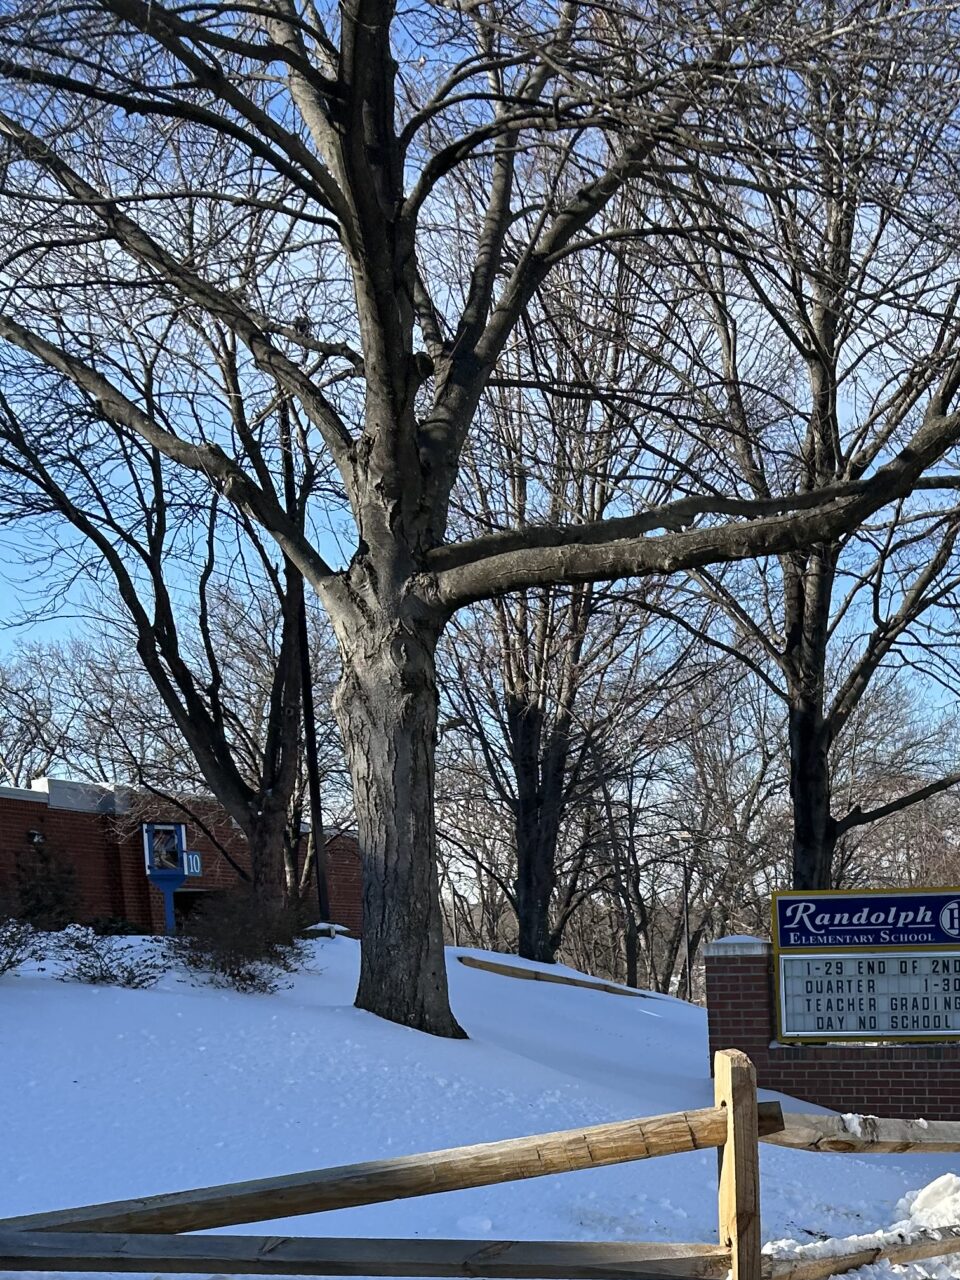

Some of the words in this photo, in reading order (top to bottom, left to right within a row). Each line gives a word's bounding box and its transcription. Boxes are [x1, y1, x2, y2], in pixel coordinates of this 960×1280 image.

[188, 854, 200, 873] 10
[783, 902, 935, 934] Randolph
[806, 961, 843, 976] 1-29
[857, 960, 886, 975] END
[900, 960, 918, 974] OF
[924, 978, 960, 993] 1-30
[806, 997, 877, 1012] TEACHER
[815, 1015, 845, 1030] DAY
[858, 1015, 877, 1030] NO
[890, 1014, 951, 1029] SCHOOL
